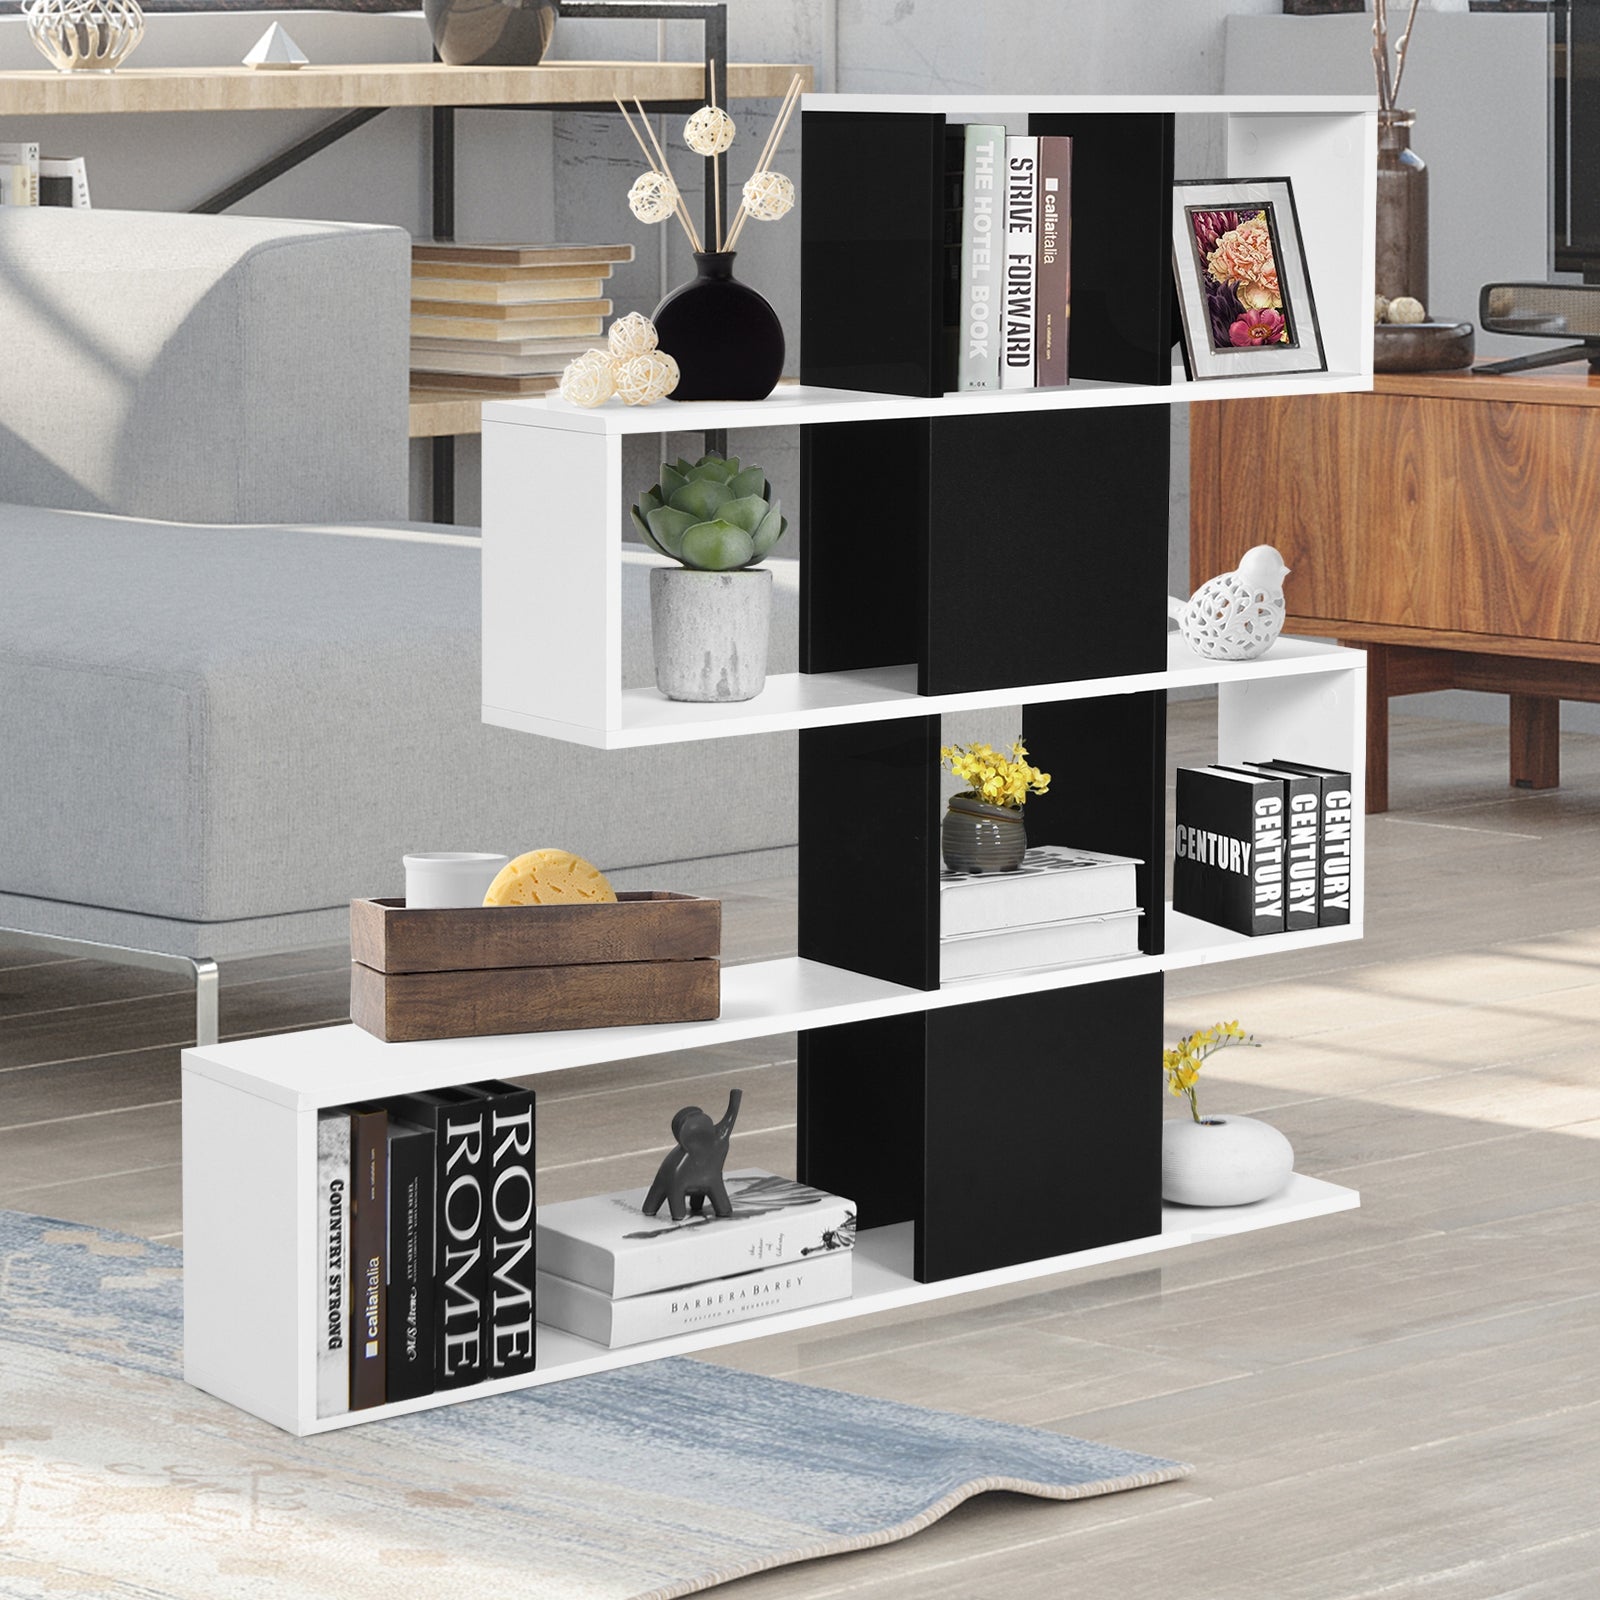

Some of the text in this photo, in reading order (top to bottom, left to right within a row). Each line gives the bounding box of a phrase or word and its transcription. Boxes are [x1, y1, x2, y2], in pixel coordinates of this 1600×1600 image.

[975, 140, 994, 190] THE
[972, 197, 993, 279] HOTEL
[1006, 158, 1034, 367] STRIVE FORWARD
[1043, 194, 1059, 264] caliaitalia
[969, 285, 990, 359] BOOK
[1176, 823, 1252, 877] CENTURY
[1254, 796, 1282, 918] CENTURY
[1289, 793, 1318, 914] CENTURY
[1323, 790, 1351, 910] CENTURY
[328, 1178, 345, 1351] COUNTRY STRONG
[444, 1112, 484, 1376] ROME
[492, 1103, 533, 1368] ROME
[364, 1256, 381, 1338] caliaitalia
[671, 1290, 746, 1313] BARBERA
[752, 1276, 803, 1296] BAREY
